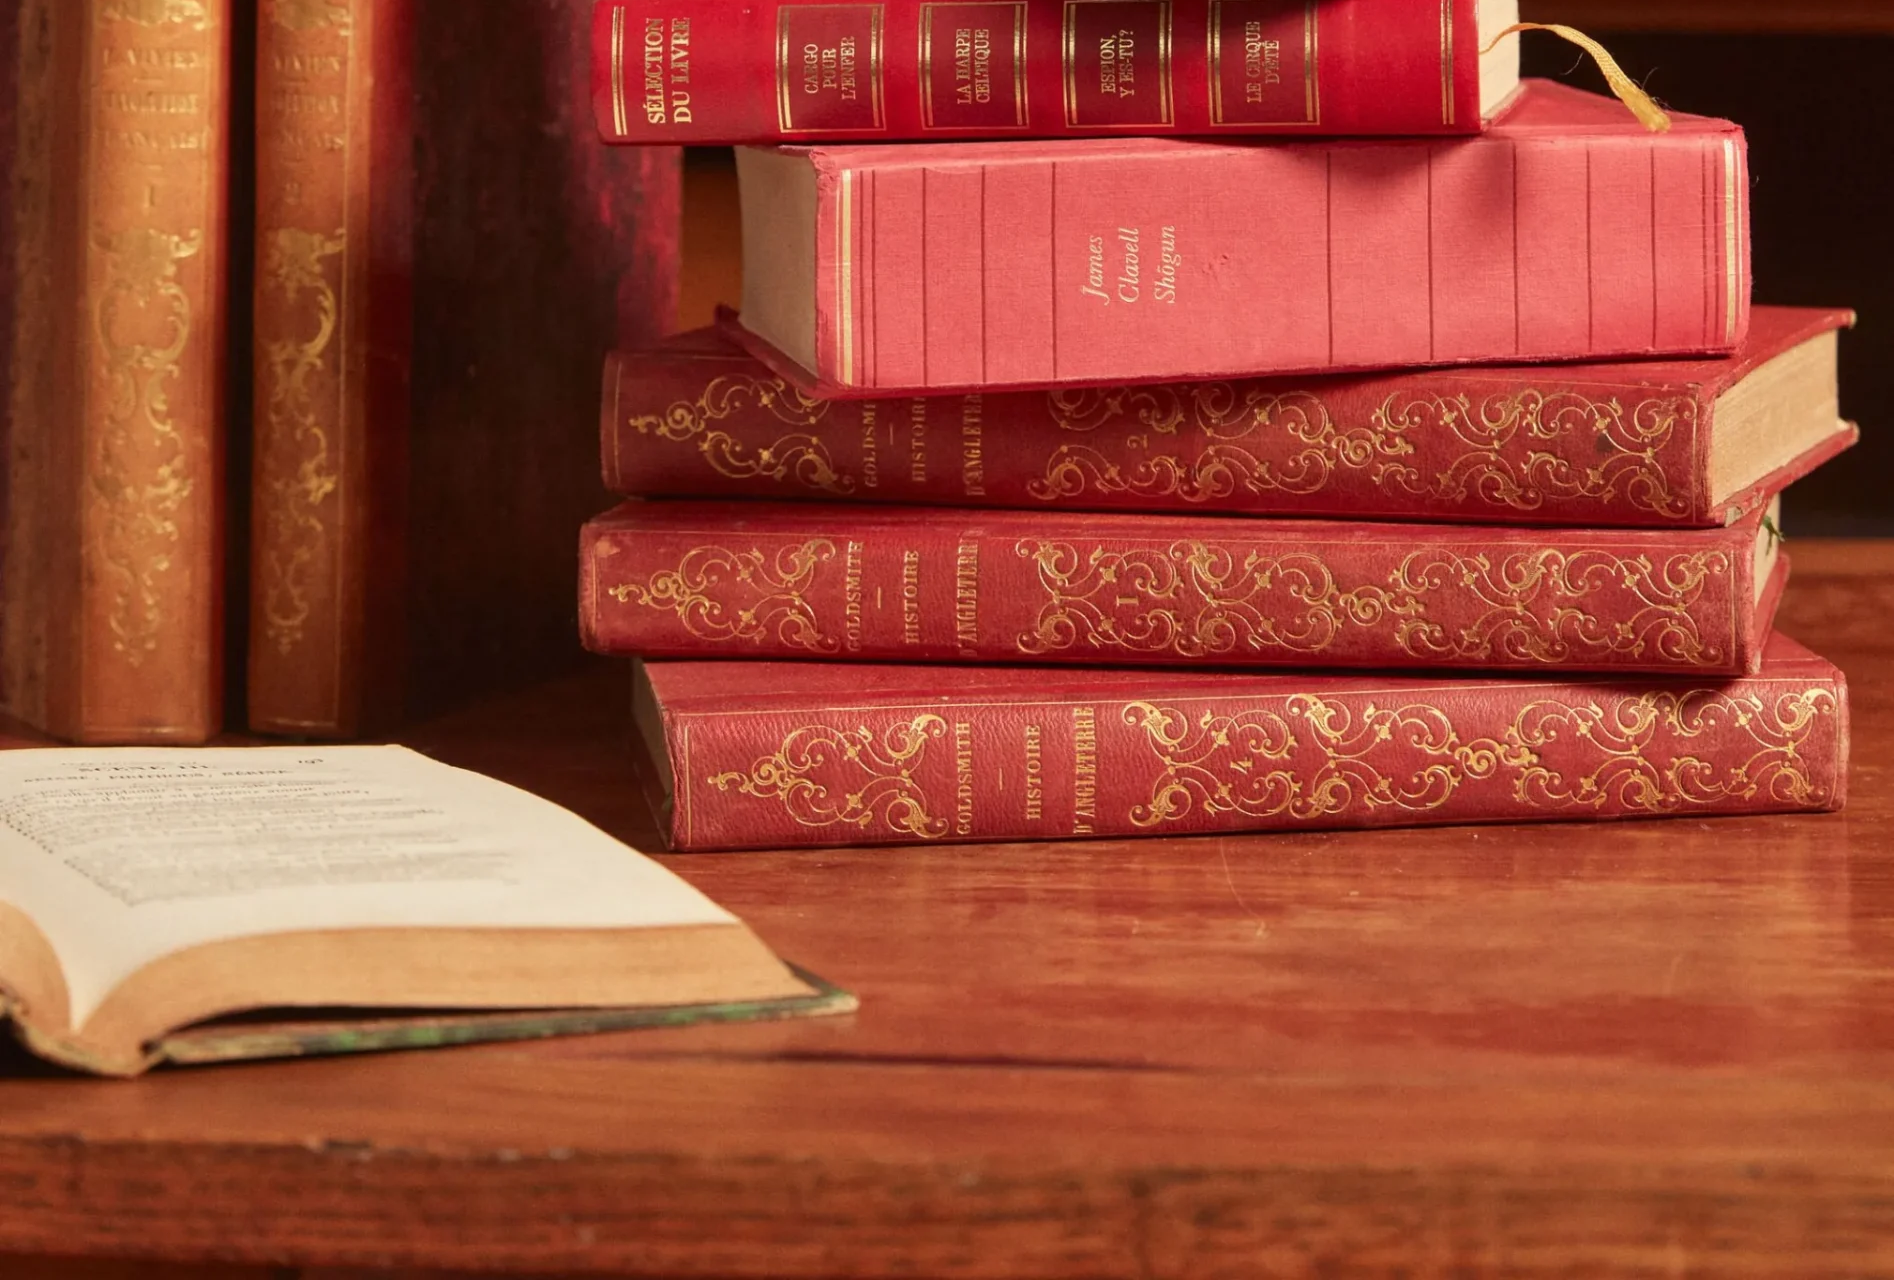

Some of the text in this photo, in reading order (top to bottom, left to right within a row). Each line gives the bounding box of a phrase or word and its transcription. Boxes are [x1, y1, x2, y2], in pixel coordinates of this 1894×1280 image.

[643, 17, 667, 124] SÉLECTION
[671, 17, 692, 124] DU LIVRE
[804, 43, 819, 94] CARGO
[822, 47, 837, 89] POUR
[841, 36, 856, 100] L'ENFER
[956, 28, 972, 105] LA HARPE
[974, 28, 991, 104] CELTIQUE
[1100, 33, 1118, 94] ESPION,
[1120, 86, 1135, 98] Y
[1245, 21, 1264, 103] LE CIRQUE
[1261, 39, 1280, 84] D'ÉTÉ
[1082, 235, 1111, 306] James
[1118, 227, 1139, 303] Clavell
[862, 403, 878, 488] GOLDSMI
[962, 394, 986, 496] D'ANGLETER
[846, 541, 864, 653] GOLDSMITH
[904, 550, 920, 645] HISTOIRE
[955, 721, 973, 836] GOLDSMITH
[1026, 725, 1042, 821] HISTOIRE
[1072, 706, 1096, 835] D'ANGLETERRE
